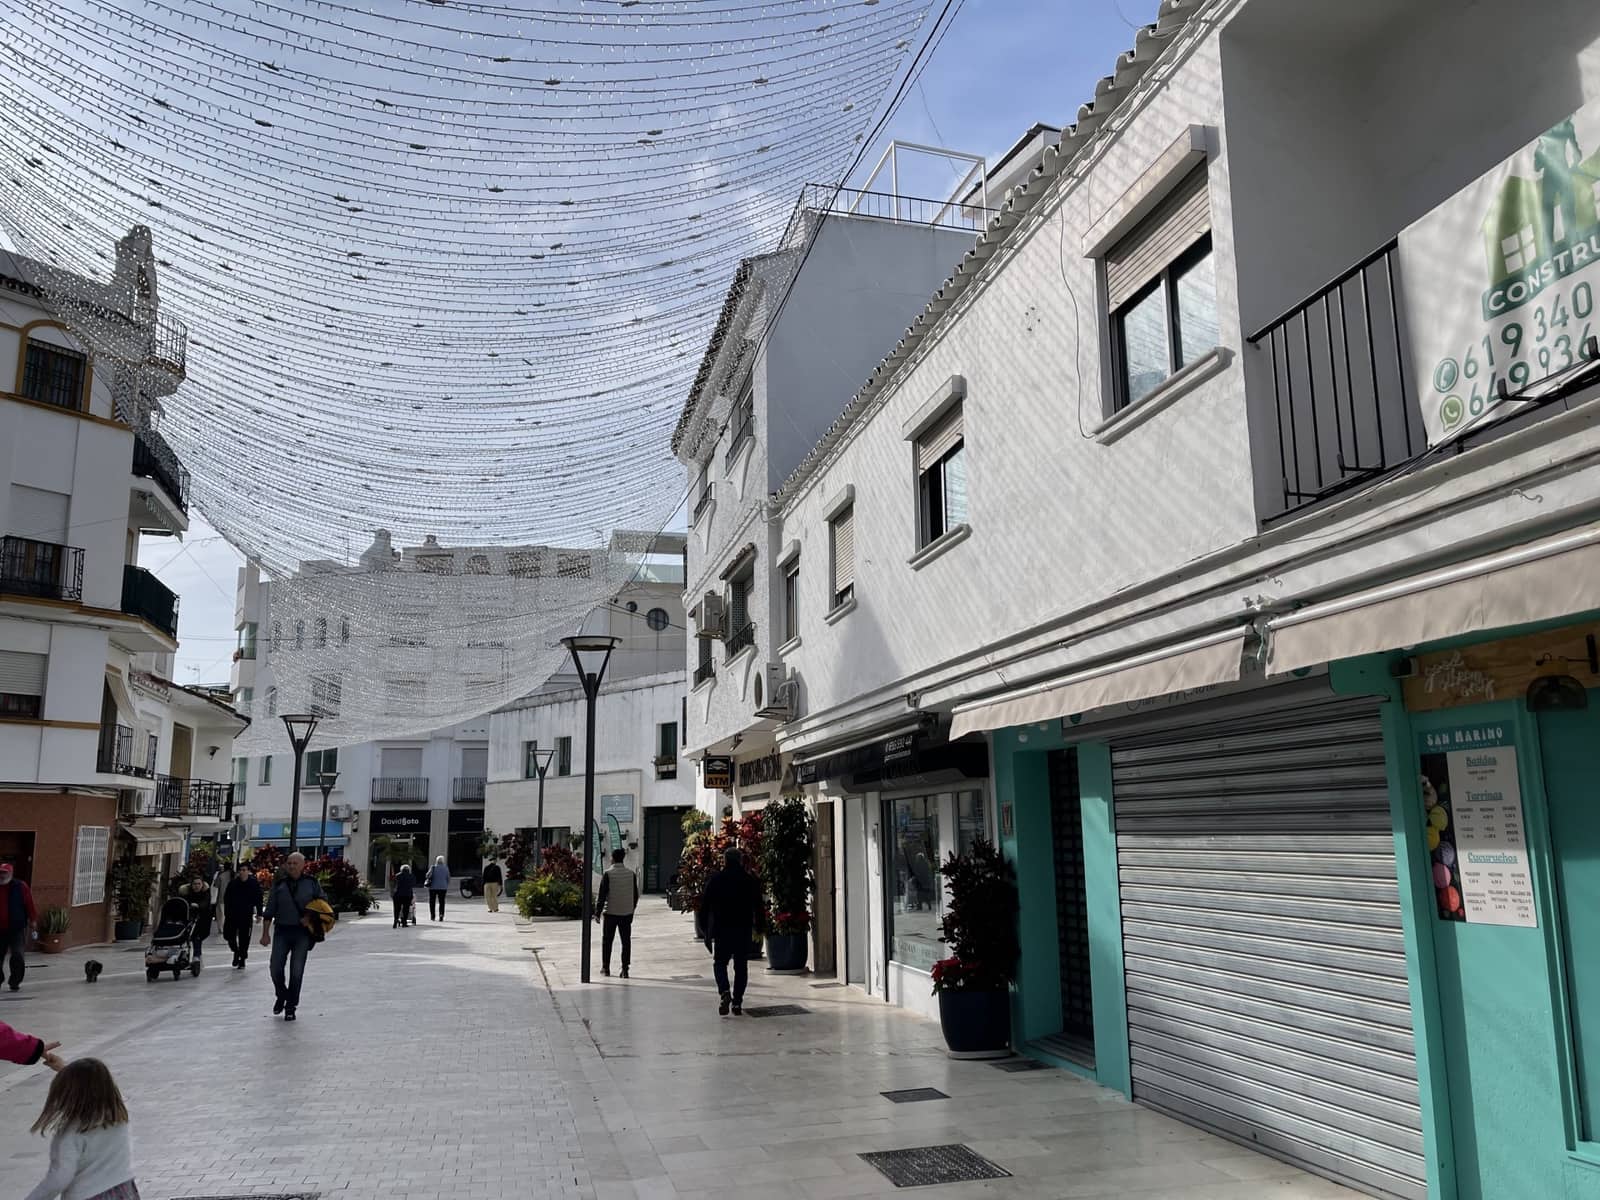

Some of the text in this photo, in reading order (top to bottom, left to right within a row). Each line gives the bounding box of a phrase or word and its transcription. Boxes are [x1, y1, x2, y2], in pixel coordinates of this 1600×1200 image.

[1463, 280, 1593, 380] 619 340
[1426, 727, 1503, 746] SAN MARINO
[707, 777, 729, 785] ATM
